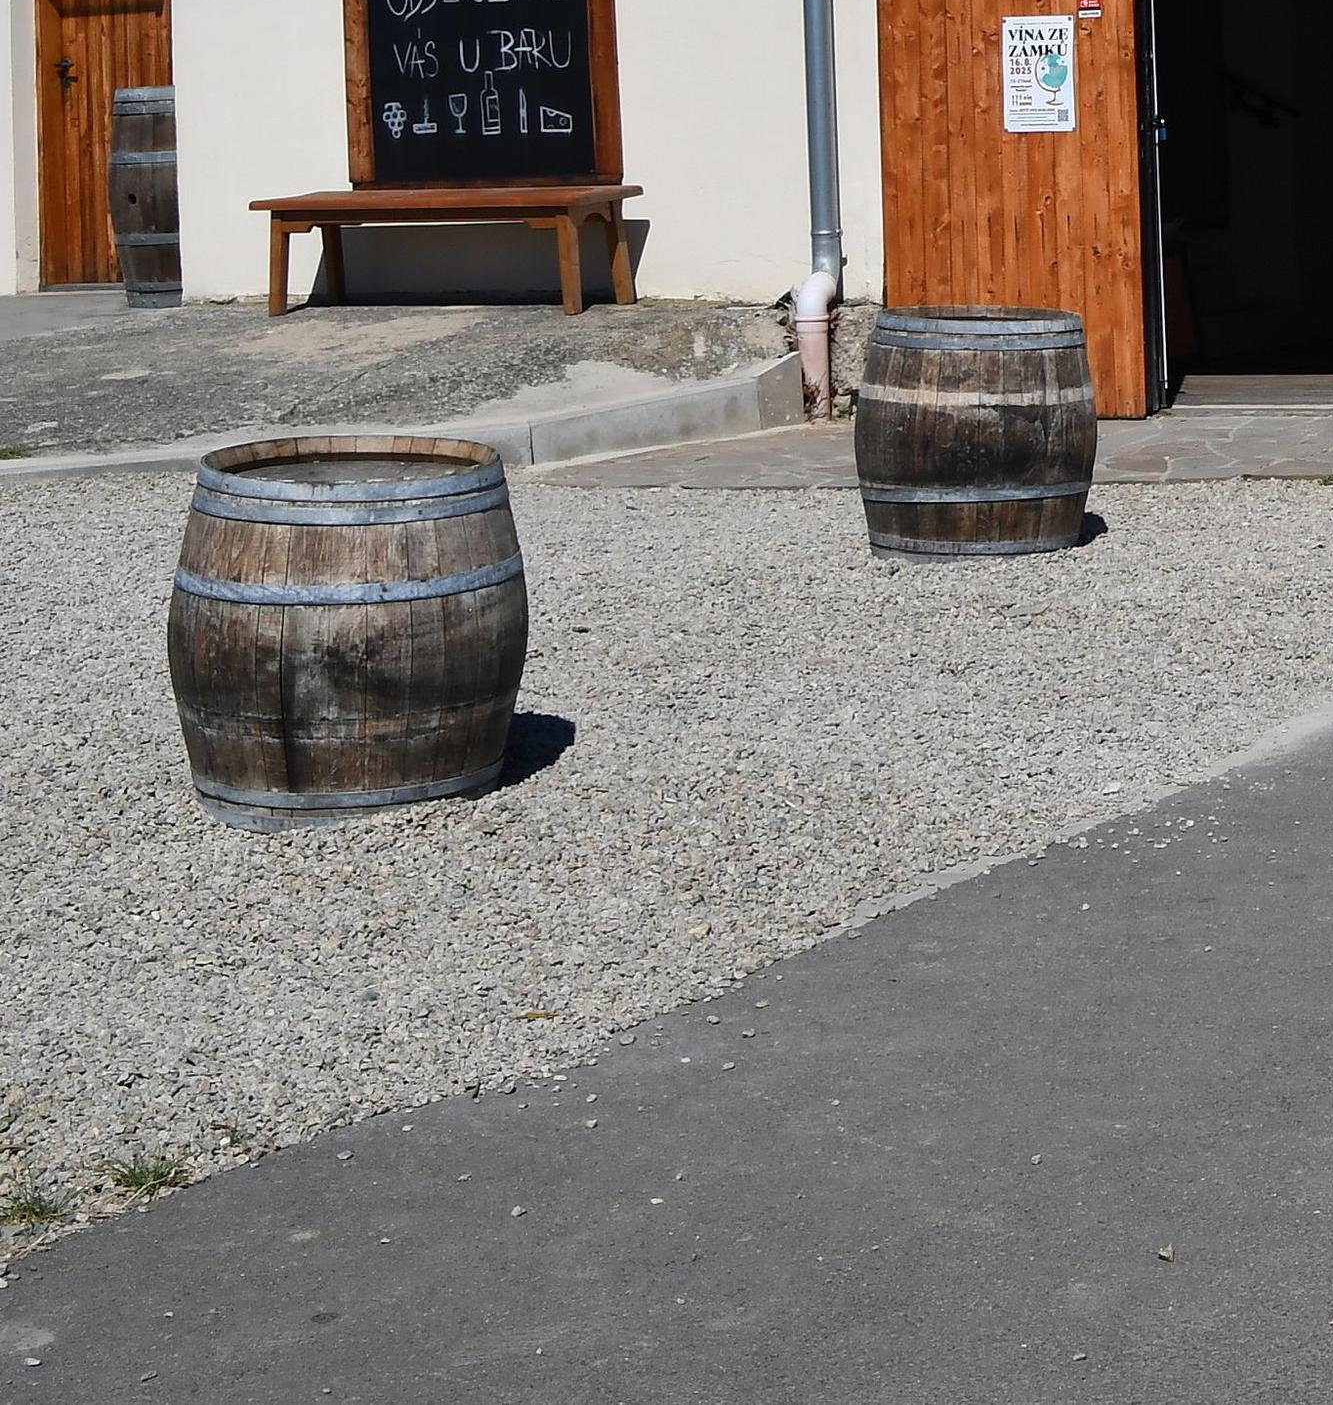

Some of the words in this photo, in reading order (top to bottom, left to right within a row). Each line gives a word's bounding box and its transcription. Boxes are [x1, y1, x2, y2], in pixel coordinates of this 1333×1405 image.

[1008, 26, 1045, 41] VÍNA
[1048, 28, 1069, 41] ZE
[393, 28, 440, 79] VÁS
[459, 37, 481, 74] U
[1010, 67, 1032, 75] 2025
